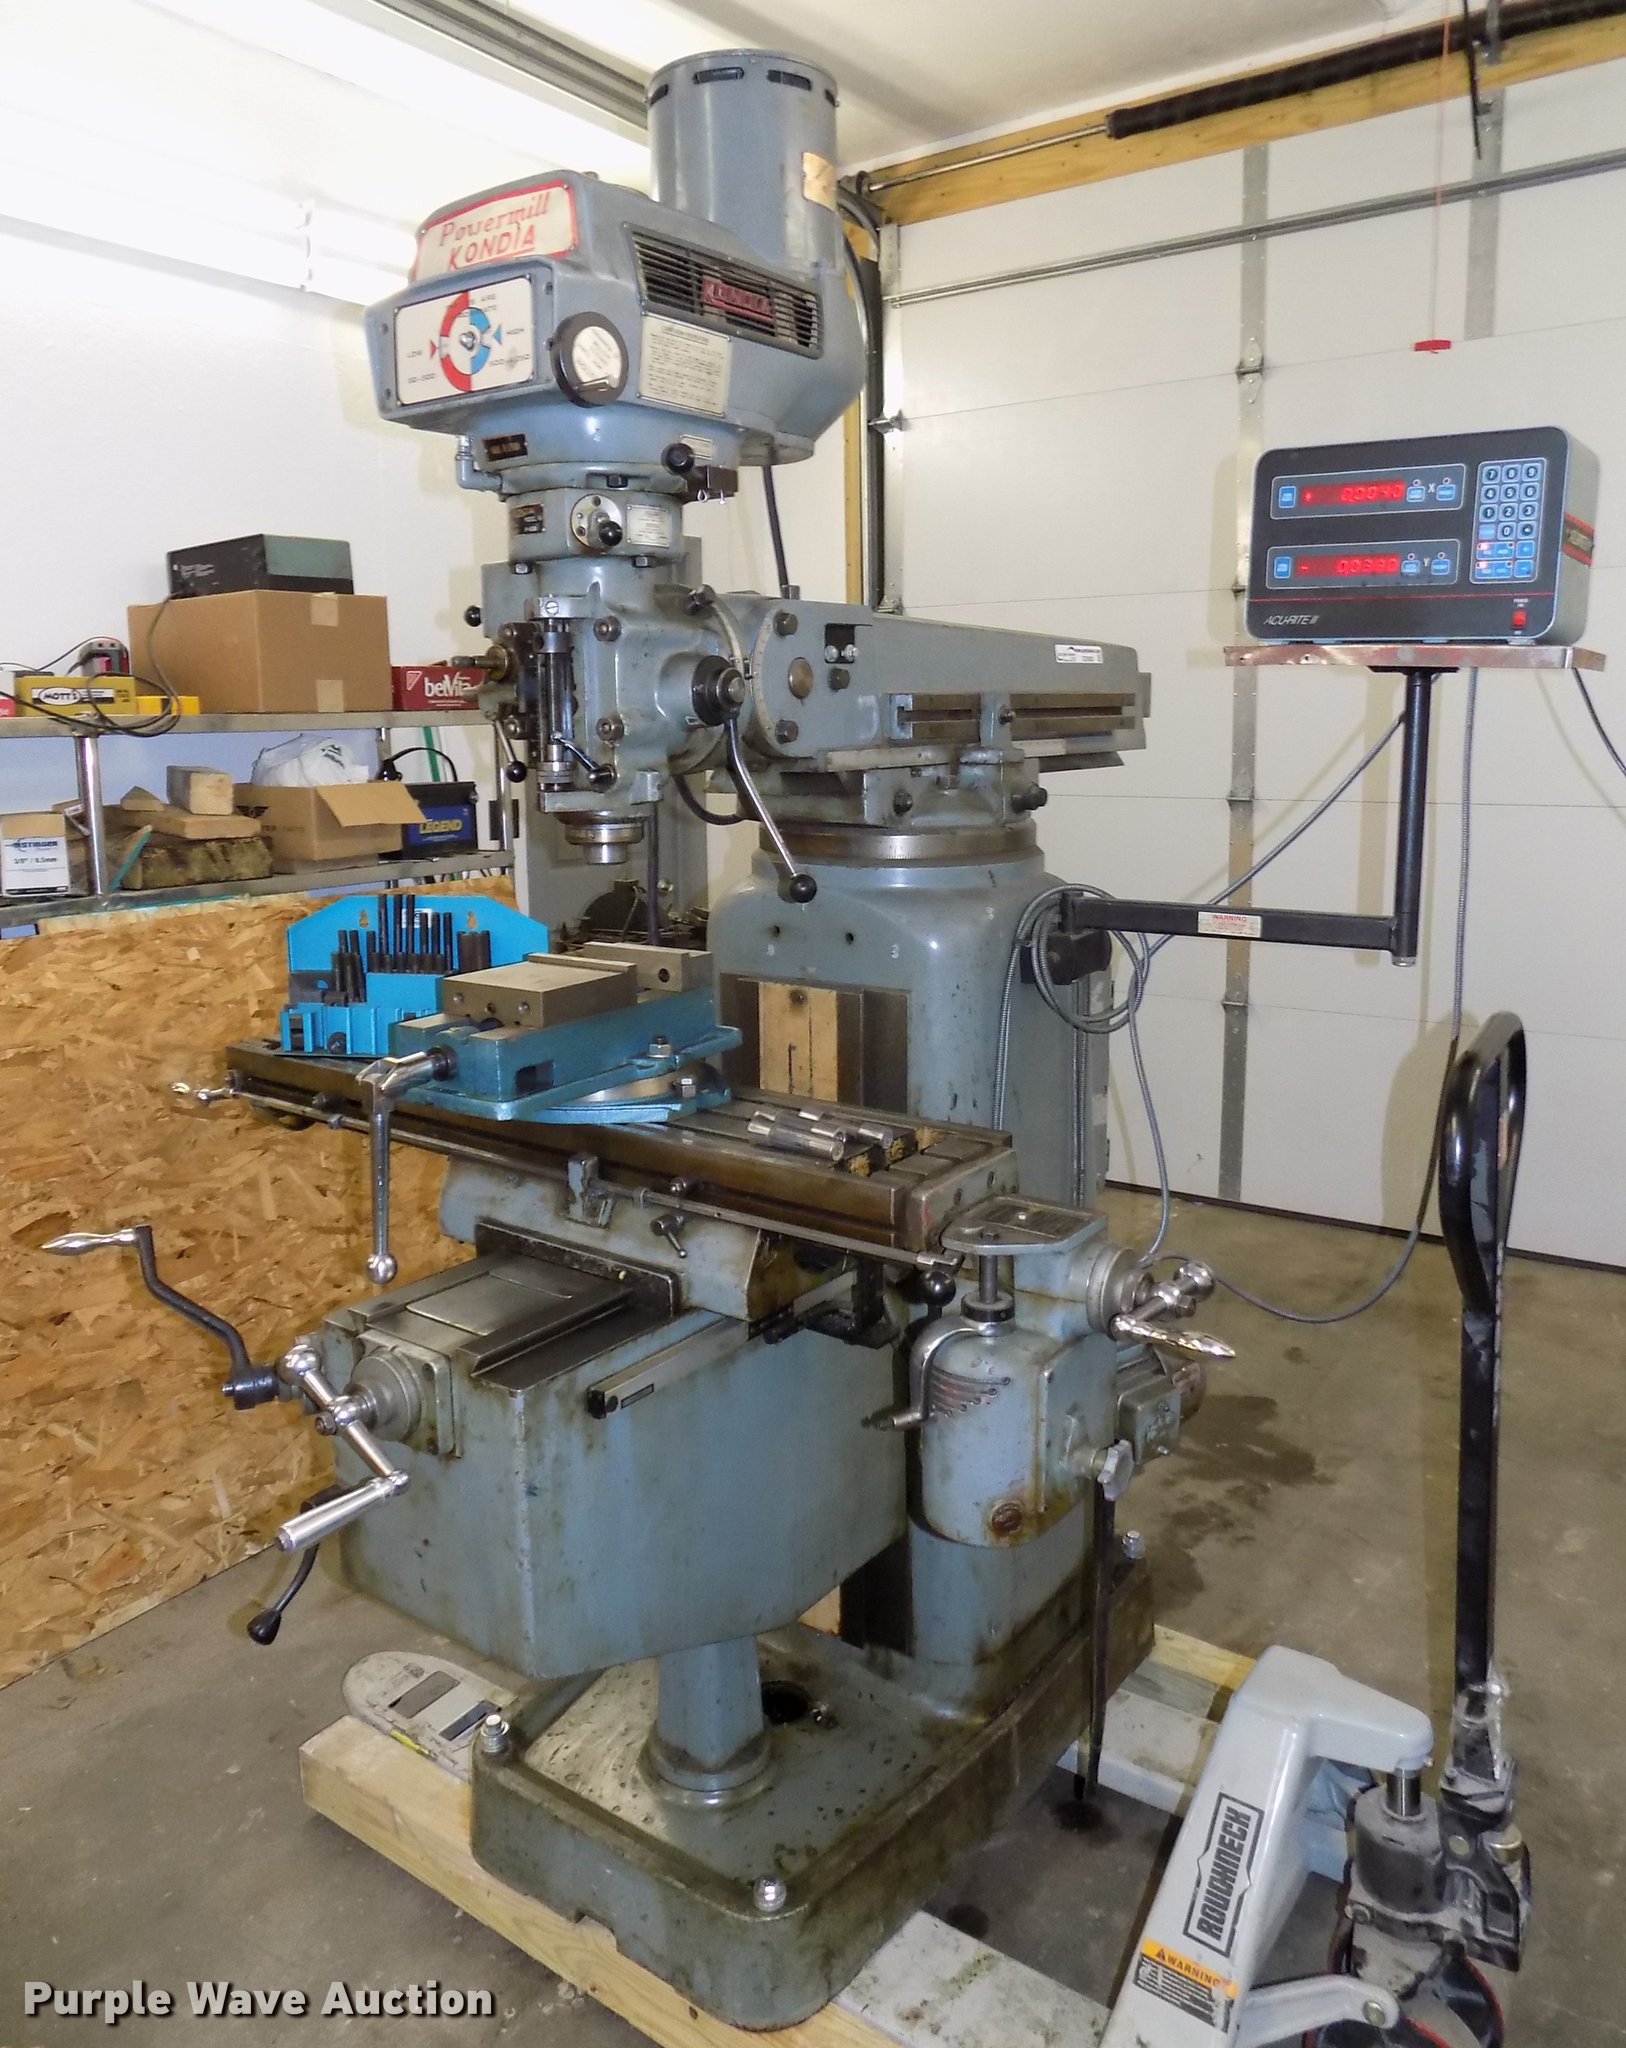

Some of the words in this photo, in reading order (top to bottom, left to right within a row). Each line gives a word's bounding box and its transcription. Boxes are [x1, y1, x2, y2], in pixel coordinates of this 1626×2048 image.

[439, 191, 551, 247] Powermill
[448, 224, 536, 271] KONDIA
[1427, 483, 1436, 493] X
[1423, 557, 1430, 568] Y
[420, 819, 462, 834] LEGEND
[1212, 914, 1247, 923] WARNING
[1196, 1806, 1252, 1941] ROUGHNECK
[1167, 1955, 1221, 1986] WARNING
